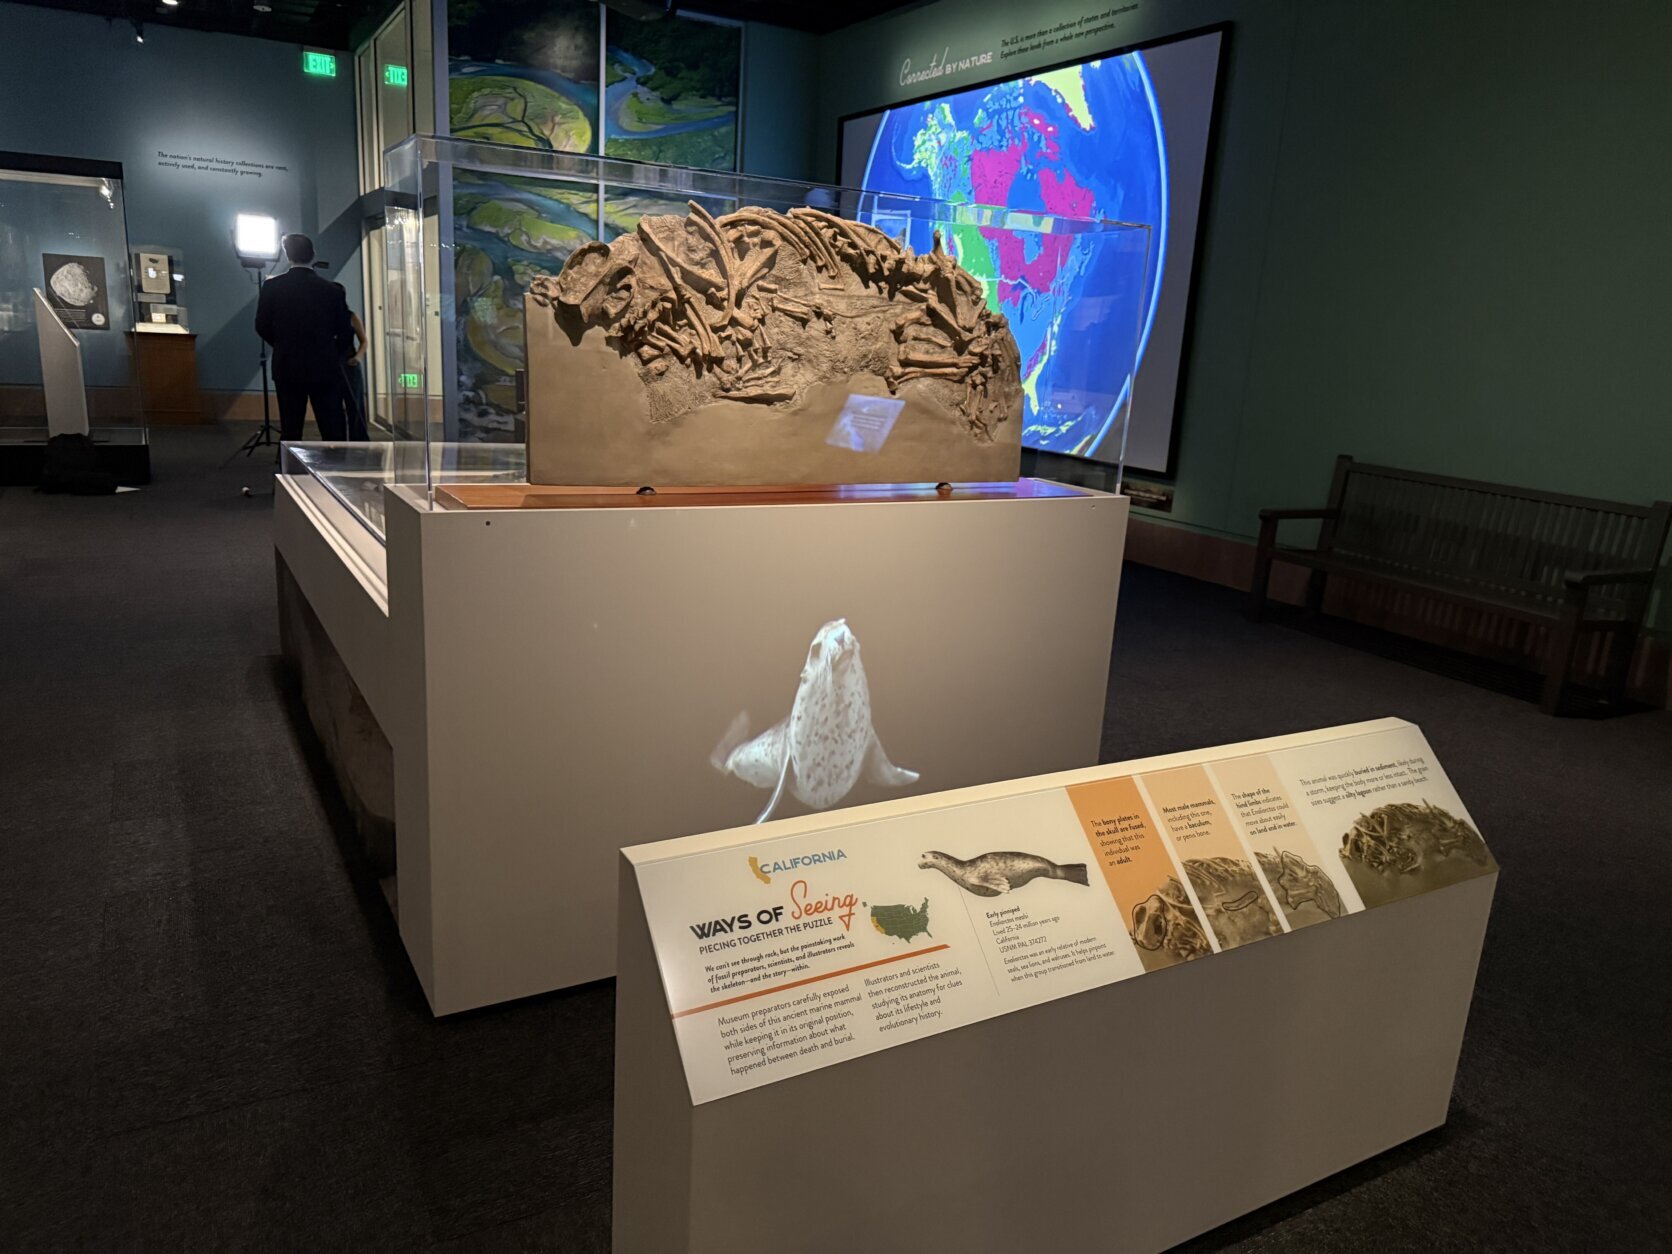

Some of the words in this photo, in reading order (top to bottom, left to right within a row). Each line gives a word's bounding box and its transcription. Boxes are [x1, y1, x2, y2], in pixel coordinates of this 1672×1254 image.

[308, 55, 330, 73] EXIT
[900, 46, 949, 86] Connected
[946, 60, 958, 74] BY
[958, 52, 992, 70] NATURE
[760, 849, 847, 874] CALIFORNIA
[690, 914, 752, 940] WAYS
[757, 906, 784, 925] OF
[790, 880, 858, 932] Seeing
[700, 940, 737, 955] PIECING
[737, 928, 784, 945] TOGETHER
[785, 924, 802, 934] THE
[803, 917, 833, 930] PUZZLE
[996, 936, 1020, 945] California
[716, 962, 730, 970] can't
[741, 953, 764, 964] through
[765, 950, 779, 958] rock,
[801, 939, 832, 952] painstaking
[716, 971, 730, 984] fossil
[732, 965, 767, 979] preparators,
[768, 958, 795, 968] scientists,
[807, 948, 836, 958] illustrators
[837, 942, 855, 951] reveals
[864, 974, 898, 987] Illustrators
[900, 969, 911, 978] and
[912, 963, 940, 974] scientists
[868, 990, 884, 998] then
[885, 977, 928, 993] reconstructed
[940, 968, 962, 979] animal,
[718, 1013, 750, 1026] Museum
[751, 1002, 792, 1020] preparators
[793, 993, 821, 1006] carefully
[823, 984, 850, 999] exposed
[872, 998, 900, 1010] studying
[909, 988, 936, 999] anatomy
[947, 981, 963, 989] clues
[876, 1011, 894, 1021] about
[904, 1001, 929, 1013] lifestyle
[930, 997, 941, 1006] and
[721, 1027, 738, 1038] both
[740, 1023, 758, 1034] sides
[783, 1010, 808, 1022] ancient
[809, 1004, 833, 1014] marine
[834, 993, 862, 1008] mammal
[724, 1039, 743, 1050] while
[744, 1033, 774, 1045] keeping
[799, 1016, 824, 1030] original
[825, 1011, 854, 1025] position,
[880, 1017, 918, 1032] evolutionary
[919, 1010, 942, 1020] history.
[728, 1048, 766, 1066] preserving
[767, 1036, 808, 1051] information
[809, 1029, 829, 1040] about
[830, 1024, 846, 1033] what
[730, 1058, 766, 1076] happened
[767, 1052, 798, 1064] between
[800, 1043, 819, 1055] death
[821, 1038, 833, 1049] and
[834, 1033, 855, 1045] burial.
